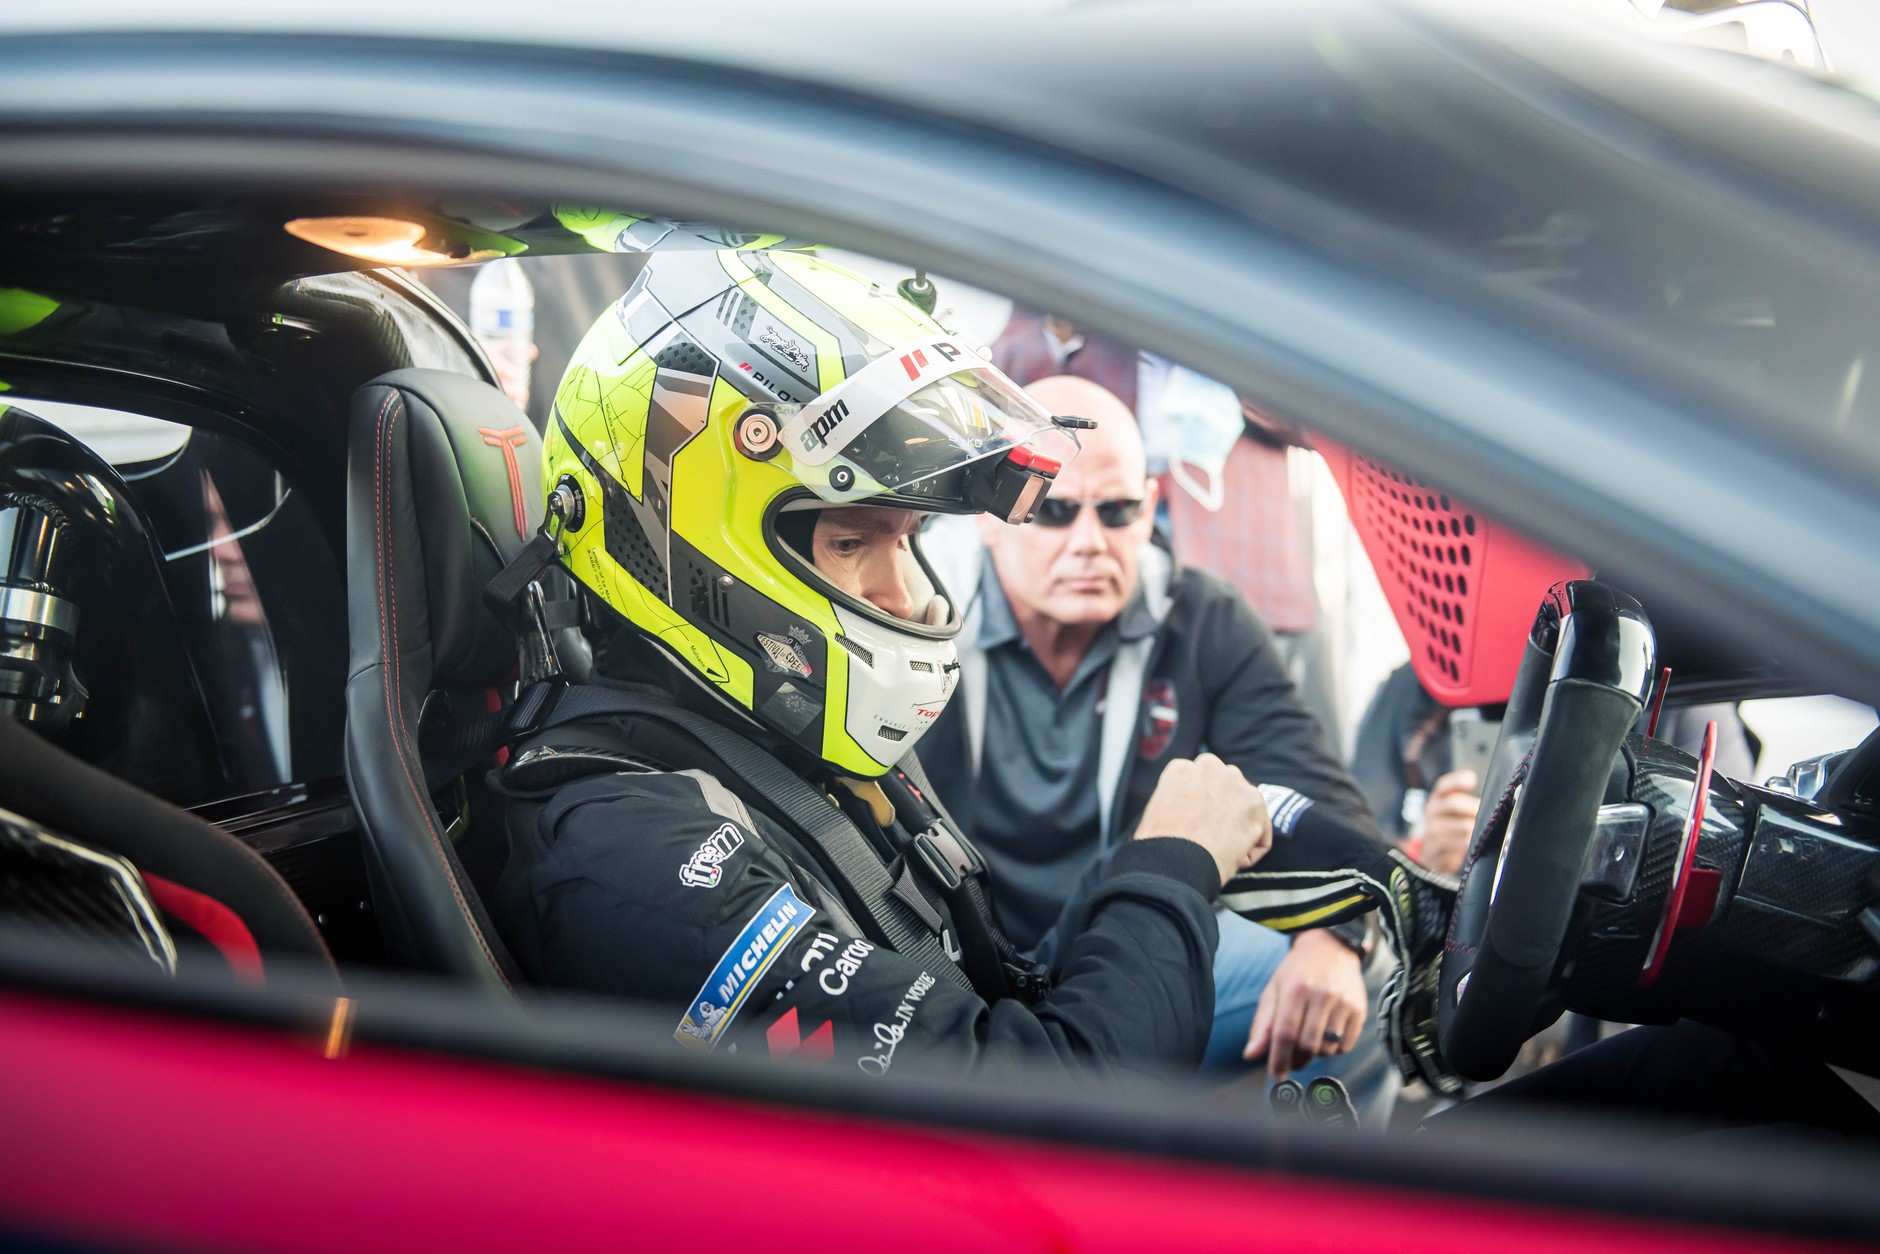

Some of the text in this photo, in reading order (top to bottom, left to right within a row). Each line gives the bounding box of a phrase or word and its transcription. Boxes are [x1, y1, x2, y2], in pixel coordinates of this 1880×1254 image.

[800, 398, 850, 453] apm
[757, 634, 784, 660] FESTIVAL
[682, 824, 743, 887] freem
[718, 901, 798, 1004] MICHELIN
[895, 1000, 916, 1023] IN
